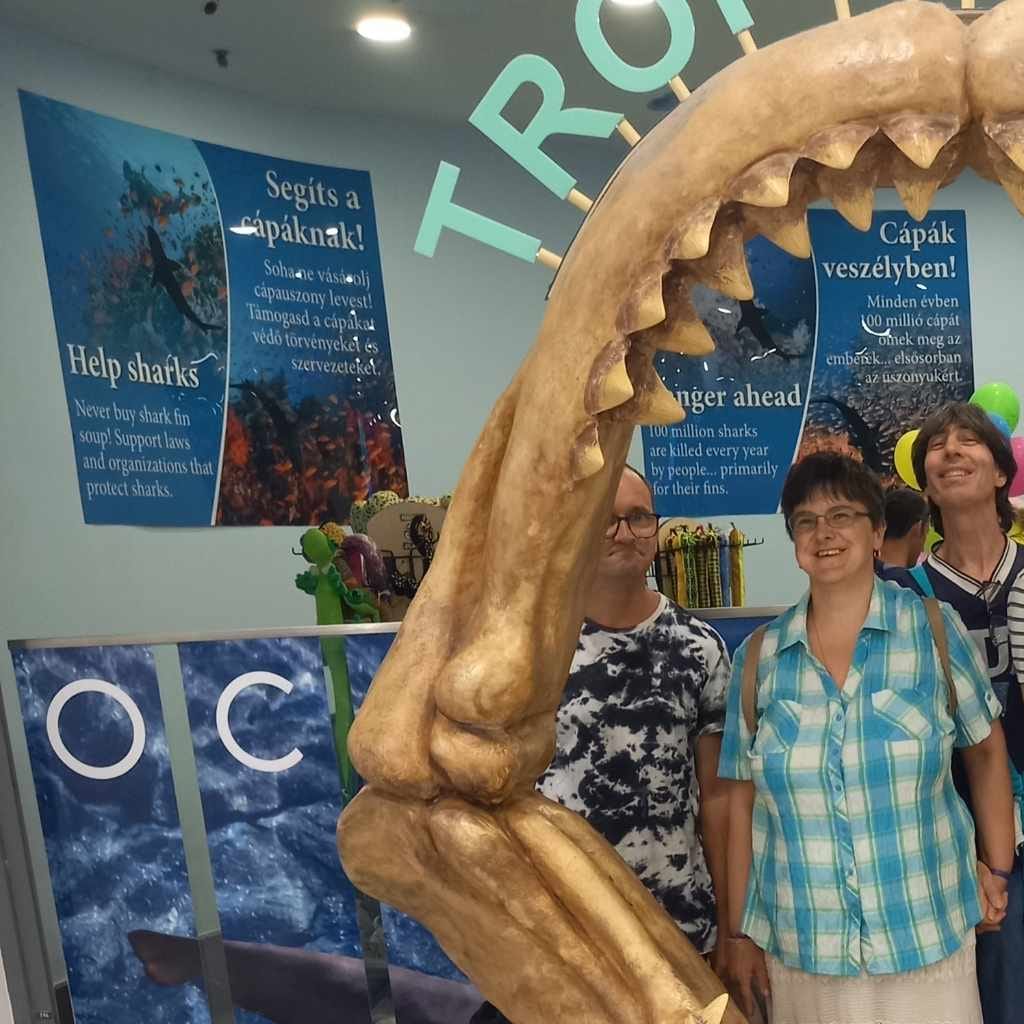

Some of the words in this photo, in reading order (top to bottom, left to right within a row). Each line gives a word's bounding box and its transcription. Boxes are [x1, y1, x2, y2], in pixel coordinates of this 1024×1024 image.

[266, 170, 338, 211] Segíts
[346, 191, 361, 210] a
[240, 209, 364, 251] cápáknak!
[880, 219, 957, 251] Cápák
[264, 258, 296, 279] Soha
[300, 268, 314, 281] ne
[822, 255, 957, 286] veszélyben!
[254, 282, 328, 309] cápauszony
[330, 290, 373, 309] levest!
[867, 294, 917, 308] Minden
[921, 294, 959, 308] évben
[246, 303, 310, 329] Támogasd
[314, 317, 321, 327] a
[886, 314, 923, 327] millió
[926, 314, 960, 330] cápát
[918, 335, 945, 348] meg
[948, 334, 961, 344] az
[66, 343, 122, 389] Help
[128, 352, 200, 389] sharks
[894, 350, 962, 365] elsősorban
[865, 374, 880, 384] az
[676, 388, 726, 414] nger
[734, 384, 802, 407] ahead
[74, 398, 110, 420] Never
[113, 402, 136, 427] buy
[140, 404, 172, 425] shark
[174, 408, 191, 427] fin
[79, 428, 112, 450] soup!
[114, 429, 162, 452] Support
[165, 432, 191, 451] laws
[650, 425, 668, 438] 100
[671, 424, 715, 438] million
[718, 424, 758, 438] sharks
[650, 446, 666, 457] are
[670, 443, 702, 457] killed
[706, 446, 739, 460] every
[742, 446, 768, 460] year
[83, 451, 106, 470] and
[108, 455, 188, 477] organizations
[190, 457, 214, 476] that
[651, 462, 664, 480] by
[668, 462, 717, 480] people...
[720, 461, 778, 480] primarily
[86, 479, 129, 500] protect
[132, 479, 174, 498] sharks.
[653, 482, 669, 496] for
[672, 481, 700, 496] their
[704, 480, 729, 496] fins.
